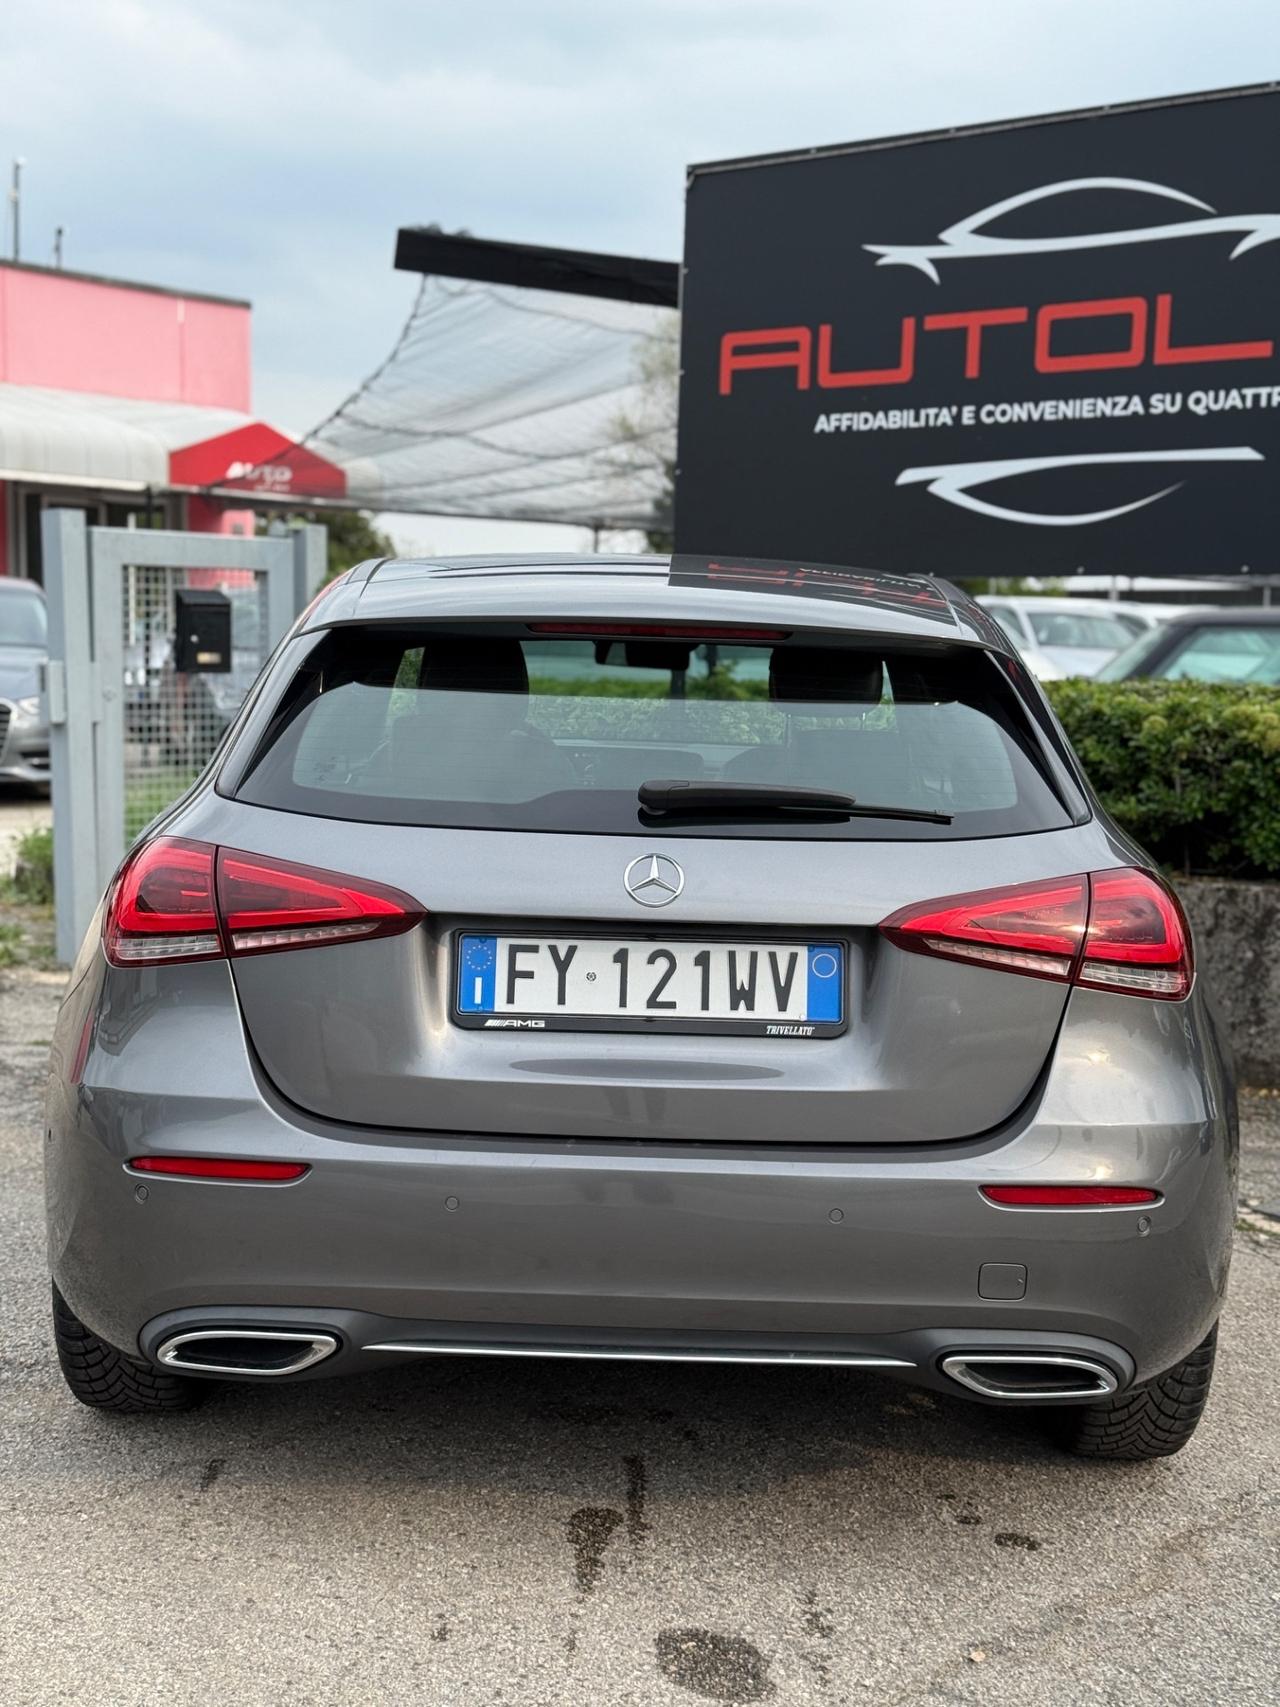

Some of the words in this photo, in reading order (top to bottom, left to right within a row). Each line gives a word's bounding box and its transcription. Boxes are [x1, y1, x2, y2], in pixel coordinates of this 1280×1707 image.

[814, 405, 957, 434] AFFIDABILITA'
[961, 404, 976, 426] E
[980, 394, 1145, 424] CONVENIENZA
[1149, 391, 1182, 415] SU
